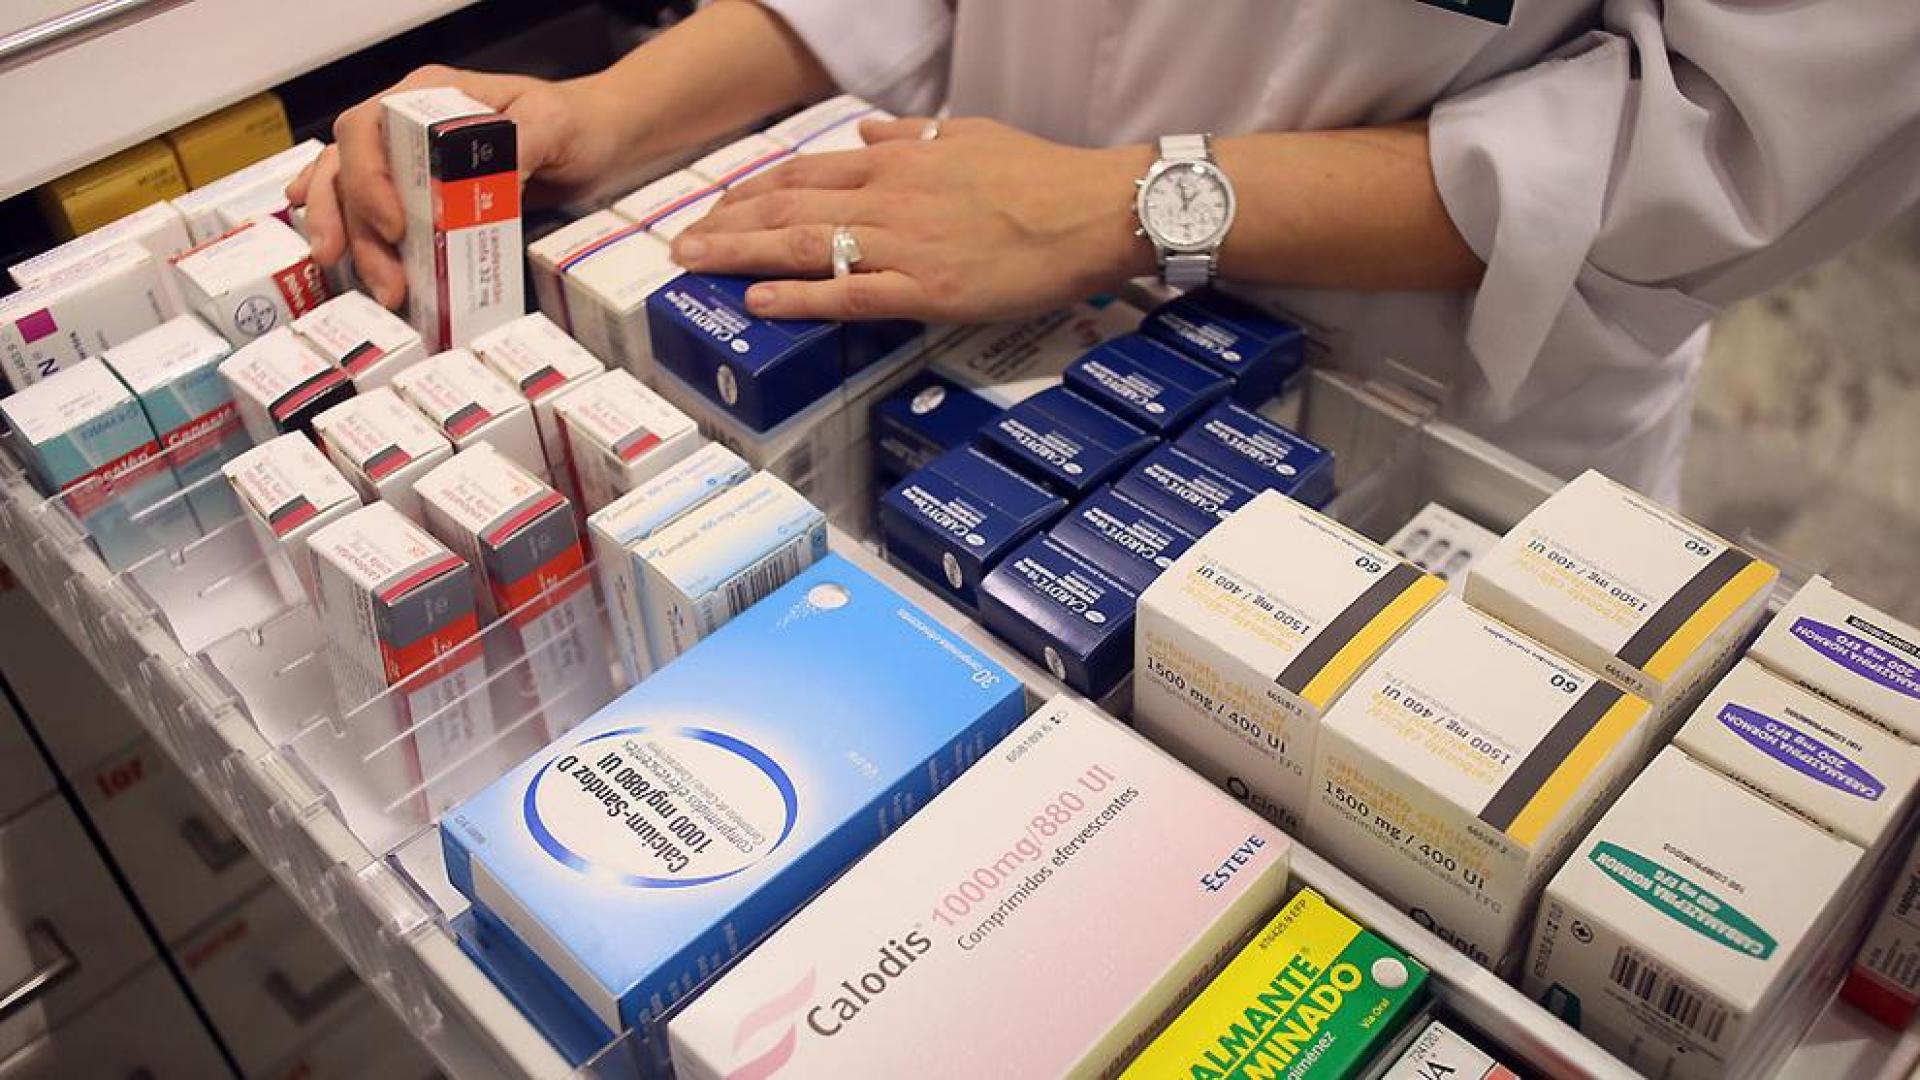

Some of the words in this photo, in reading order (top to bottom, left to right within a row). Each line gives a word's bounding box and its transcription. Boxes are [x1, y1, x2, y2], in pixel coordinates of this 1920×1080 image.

[916, 501, 973, 537] CARDYL
[1526, 538, 1548, 553] UI
[1682, 538, 1712, 558] 60
[1193, 563, 1217, 580] UI
[1352, 554, 1384, 575] 60
[1545, 550, 1577, 570] 400
[1211, 574, 1245, 596] 400
[1584, 570, 1611, 588] mg
[1034, 574, 1090, 616] CARDYL
[1249, 593, 1277, 612] mg
[1608, 586, 1649, 612] 1500
[1271, 608, 1312, 635] 1500
[971, 670, 1000, 689] 30
[1380, 683, 1403, 700] UI
[1547, 672, 1579, 695] 60
[1146, 654, 1185, 692] 1500
[1190, 684, 1212, 712] mg
[1227, 706, 1261, 741] 400
[1267, 730, 1286, 755] UI
[1400, 695, 1436, 720] 400
[1443, 719, 1471, 740] mg
[596, 752, 624, 774] UI
[1468, 735, 1512, 765] 1500
[556, 755, 579, 773] D
[1776, 740, 1878, 797] CARBAMAZEPINA
[614, 767, 677, 819] mg/880
[572, 765, 690, 873] Calcium-Sandoz
[667, 815, 713, 854] 1000
[1324, 777, 1368, 819] 1500
[1374, 813, 1401, 843] mg
[1418, 838, 1456, 875] 400
[1462, 866, 1484, 892] UI
[957, 862, 1056, 953] Comprimidos
[1050, 785, 1141, 868] efervescentes
[1199, 834, 1266, 895] ESTEVE
[806, 925, 932, 1040] Calodis
[931, 786, 1088, 930] 1000mg/880
[1077, 763, 1118, 798] UI
[1650, 883, 1766, 957] CARBAMAZEPINA
[1182, 952, 1320, 1080] ALMANTE
[1243, 963, 1363, 1080] MINADO
